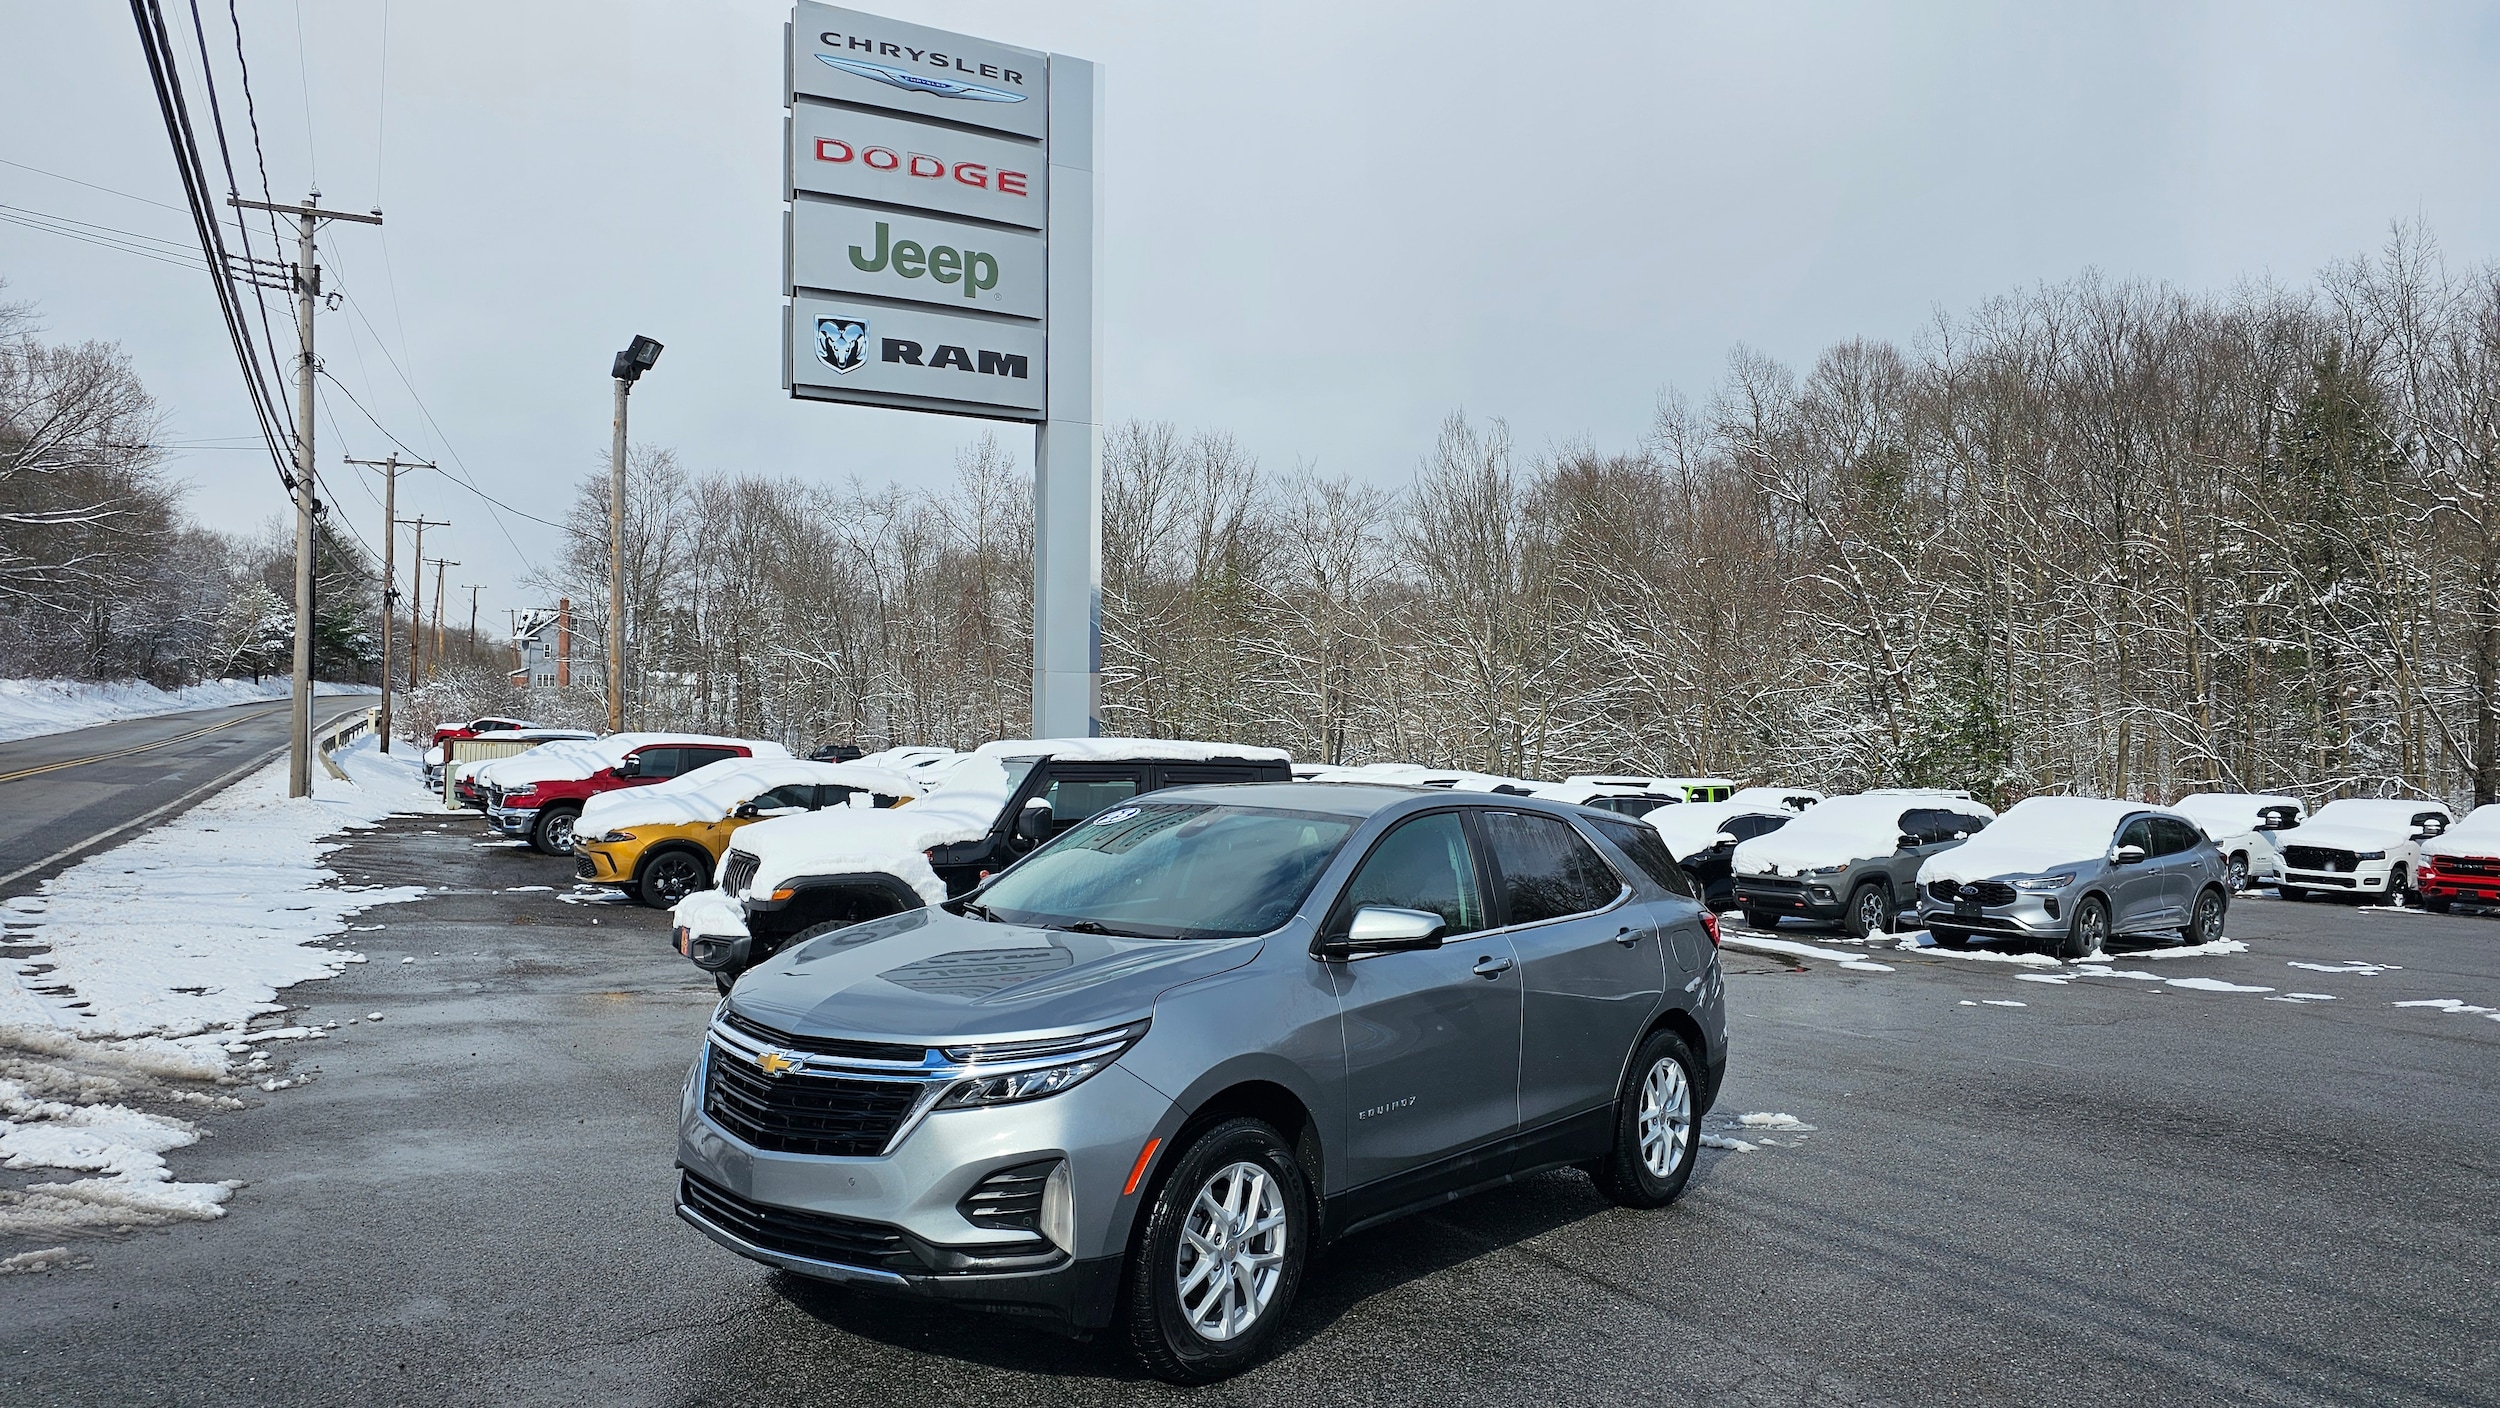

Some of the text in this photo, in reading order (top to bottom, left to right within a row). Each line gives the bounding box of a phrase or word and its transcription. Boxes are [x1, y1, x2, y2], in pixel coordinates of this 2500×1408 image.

[820, 32, 1023, 86] CHRYSLER
[814, 136, 1028, 197] DODGE
[848, 221, 999, 298] Jeep
[881, 337, 1028, 379] RAM
